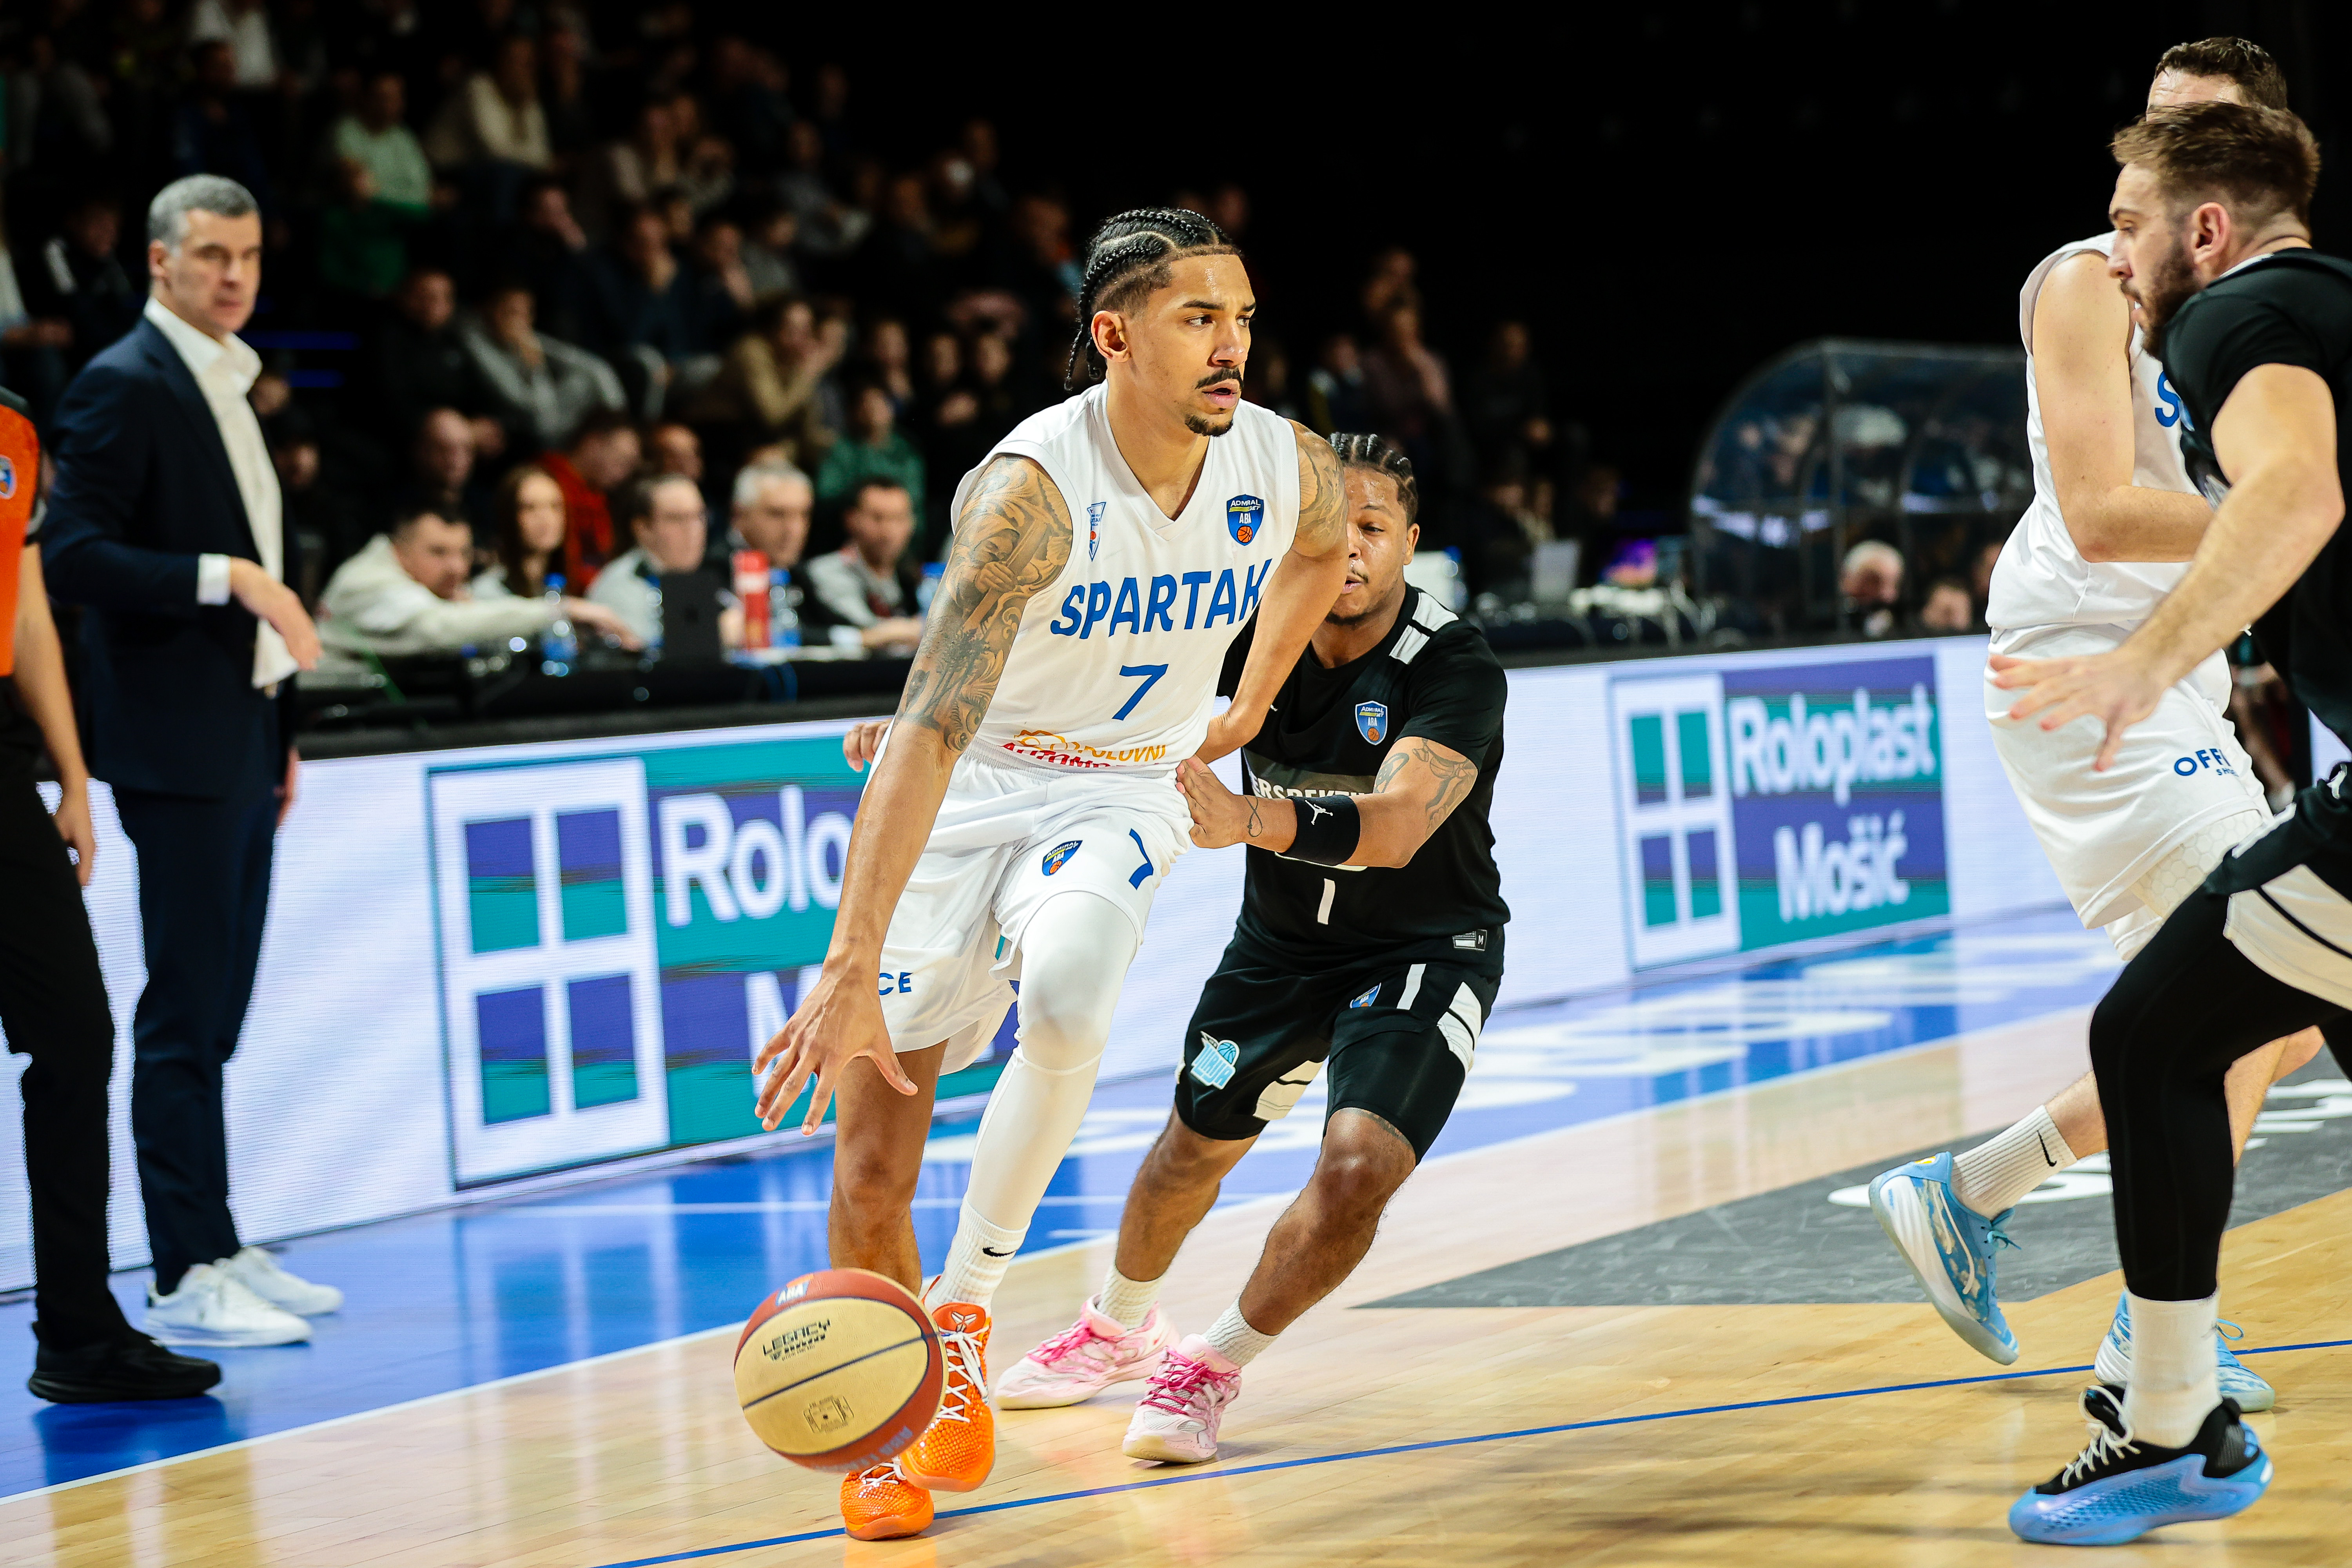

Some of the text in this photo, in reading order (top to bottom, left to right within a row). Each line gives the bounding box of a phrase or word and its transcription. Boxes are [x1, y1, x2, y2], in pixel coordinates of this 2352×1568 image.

[1239, 512, 1252, 524] ABA
[1050, 558, 1273, 639] SPARTAK
[1112, 664, 1169, 720] 7
[1368, 717, 1377, 726] ABA
[1726, 681, 1936, 807] Roloplast
[2174, 748, 2231, 776] OFFI
[657, 784, 855, 928] Rolo
[1129, 828, 1154, 890] 7
[1773, 810, 1911, 922] Mošić
[1318, 878, 1336, 925] 1
[1478, 935, 1484, 945] M
[763, 1318, 831, 1356] LEGACY
